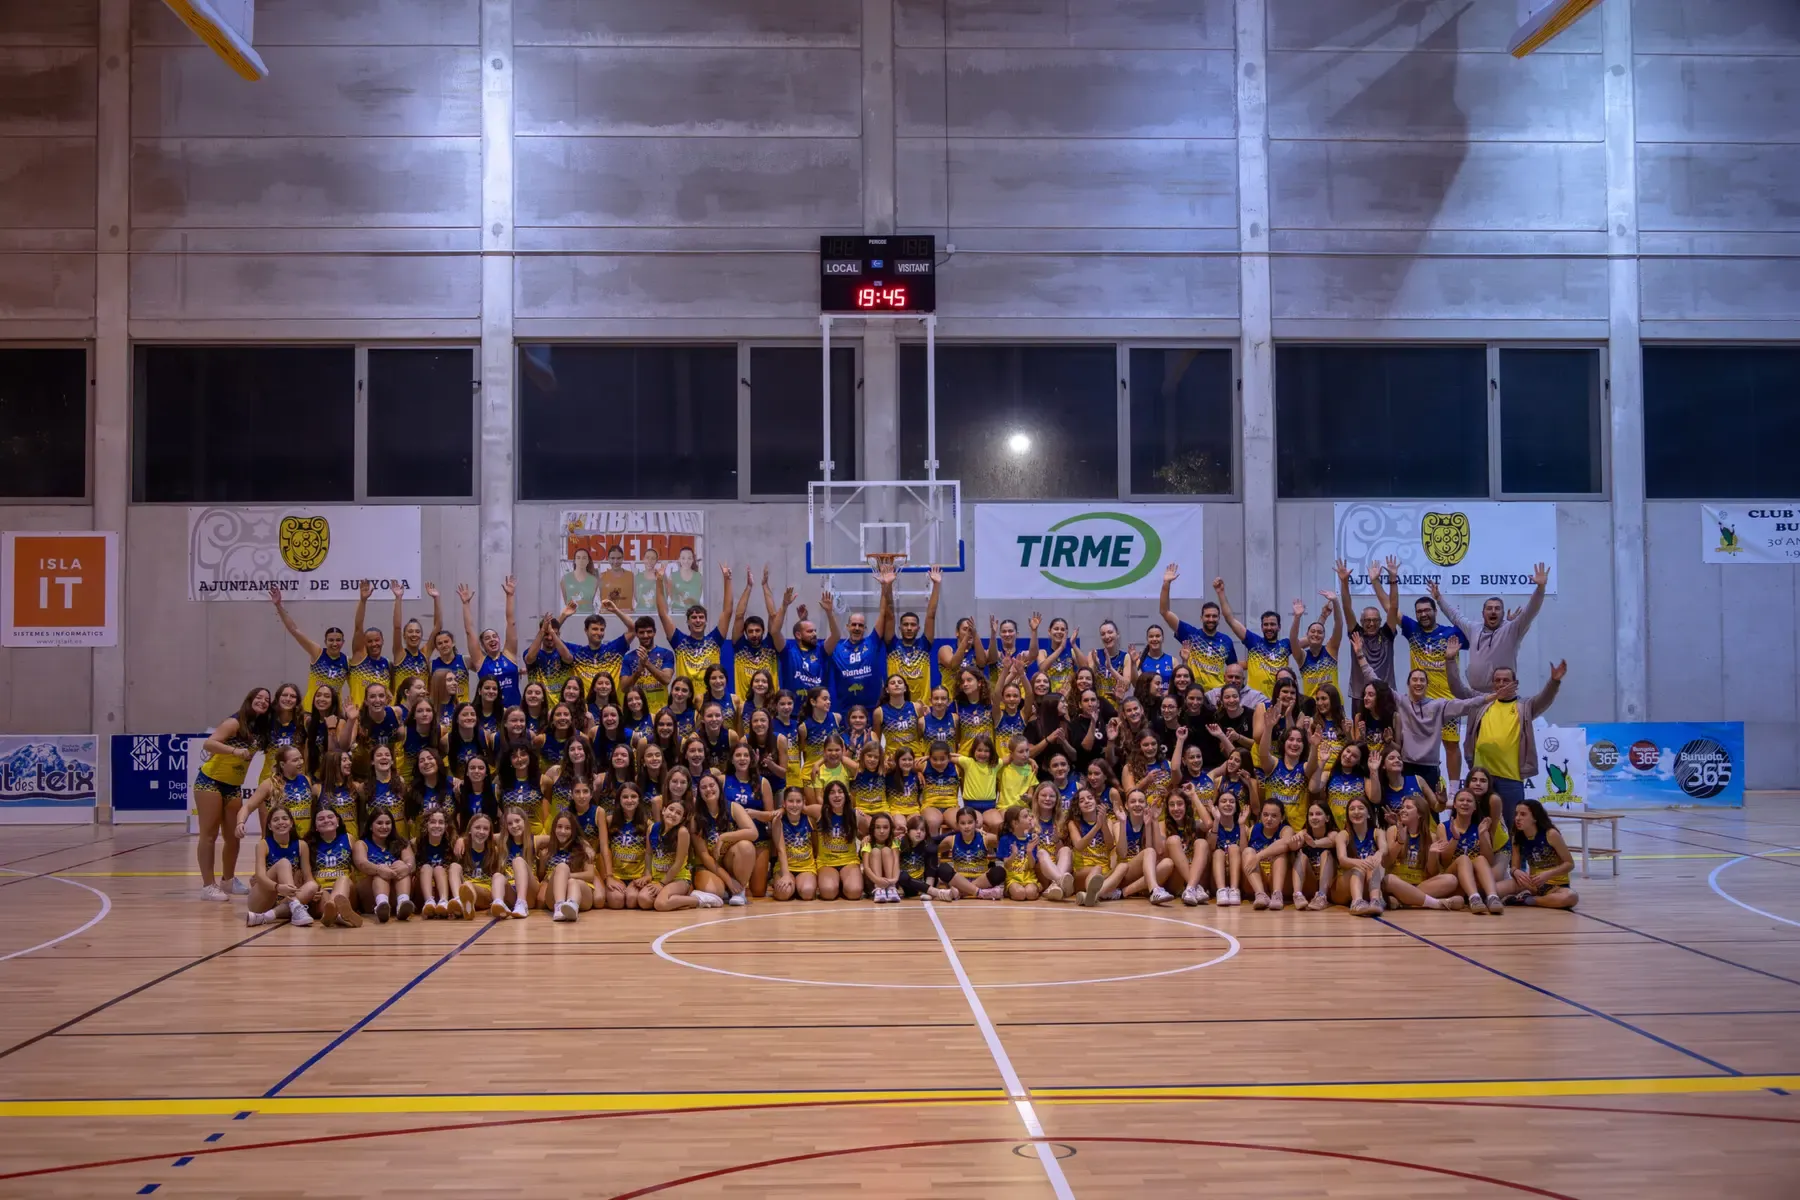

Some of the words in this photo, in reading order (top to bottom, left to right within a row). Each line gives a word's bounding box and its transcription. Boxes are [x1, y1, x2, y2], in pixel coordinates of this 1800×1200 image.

[827, 264, 858, 272] LOCAL
[898, 263, 929, 272] VISITANT
[858, 289, 905, 306] 19:45
[1748, 510, 1794, 518] CLUB
[1017, 535, 1134, 568] TIRME
[40, 558, 82, 570] ISLA
[199, 579, 299, 592] AJUNTAMENT
[310, 579, 329, 591] DE
[340, 579, 410, 591] BUYOA
[1451, 575, 1470, 585] DE
[1480, 574, 1537, 585] BUNYOL
[39, 577, 82, 609] IT
[1596, 752, 1619, 764] 365
[1636, 752, 1660, 764] 365
[1681, 752, 1724, 763] Bunyola
[15, 777, 34, 791] des
[37, 763, 94, 791] teix
[1688, 763, 1732, 785] 365
